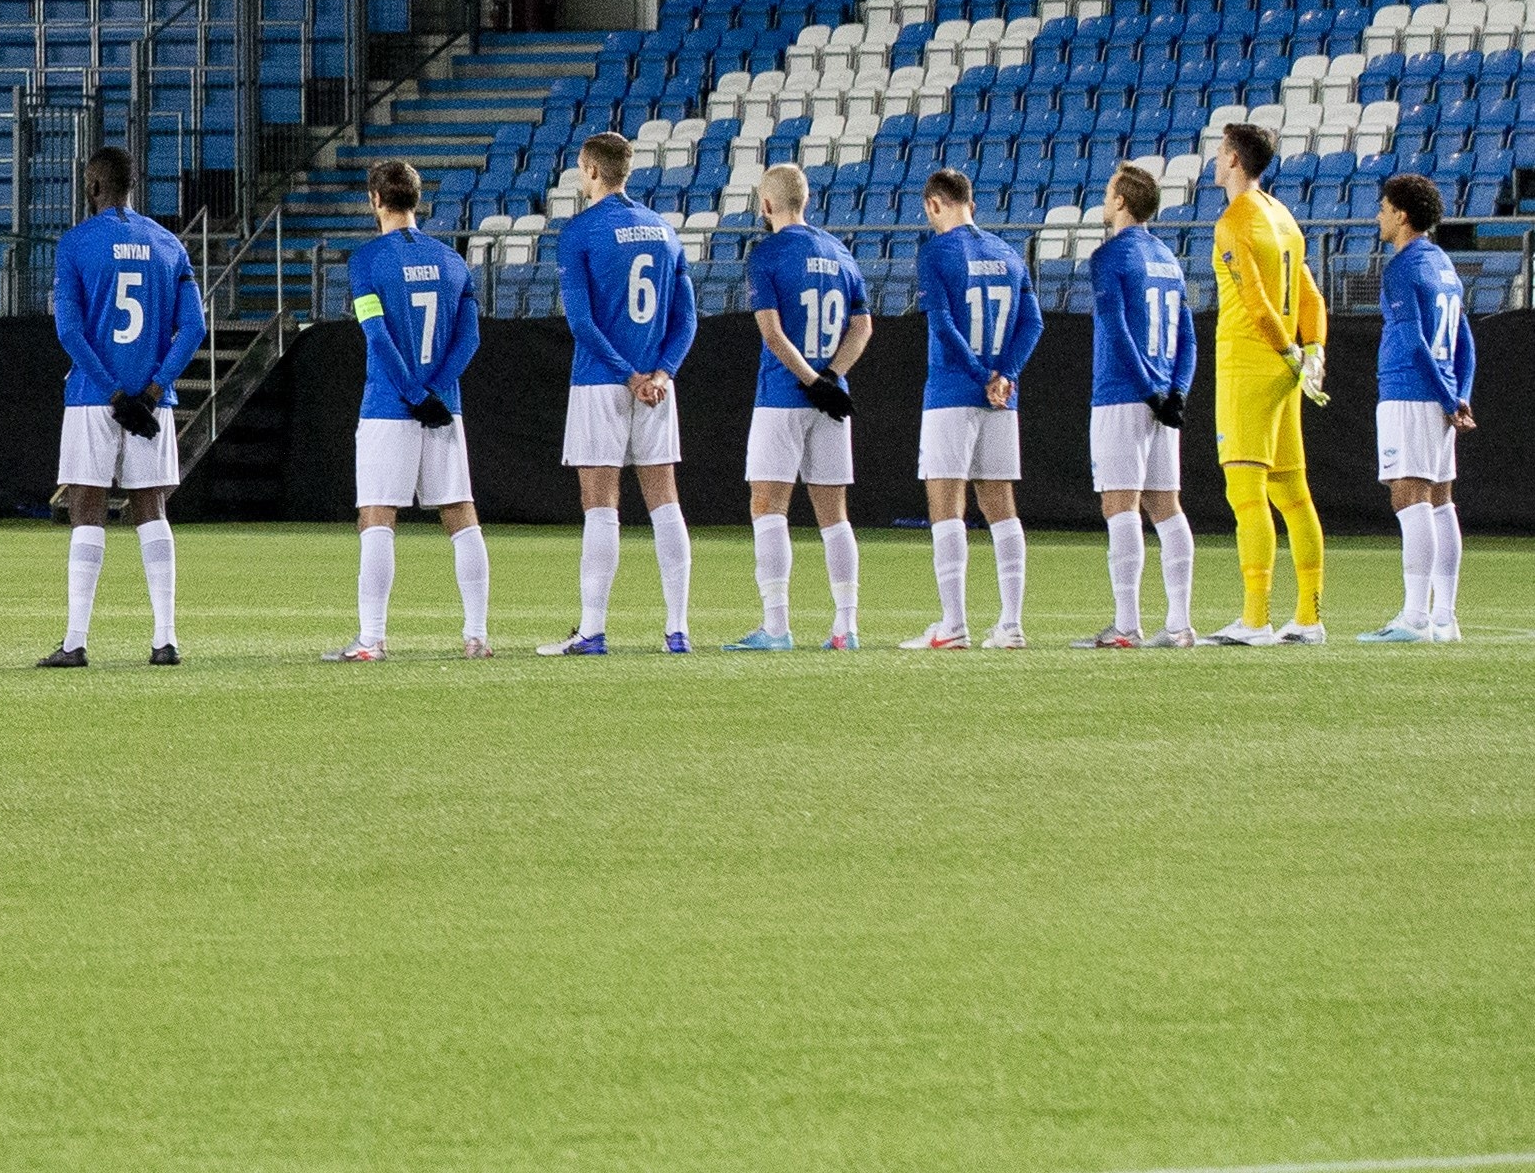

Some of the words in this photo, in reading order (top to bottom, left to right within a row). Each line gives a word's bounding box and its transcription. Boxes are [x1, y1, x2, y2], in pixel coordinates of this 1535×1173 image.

[113, 243, 150, 261] SINYAN
[1281, 249, 1292, 317] 1
[113, 272, 144, 344] 5
[628, 254, 657, 324] 6
[800, 289, 844, 359] 19
[966, 285, 1013, 356] 17
[1145, 287, 1180, 359] 11
[411, 291, 438, 365] 7
[1434, 293, 1460, 361] 20
